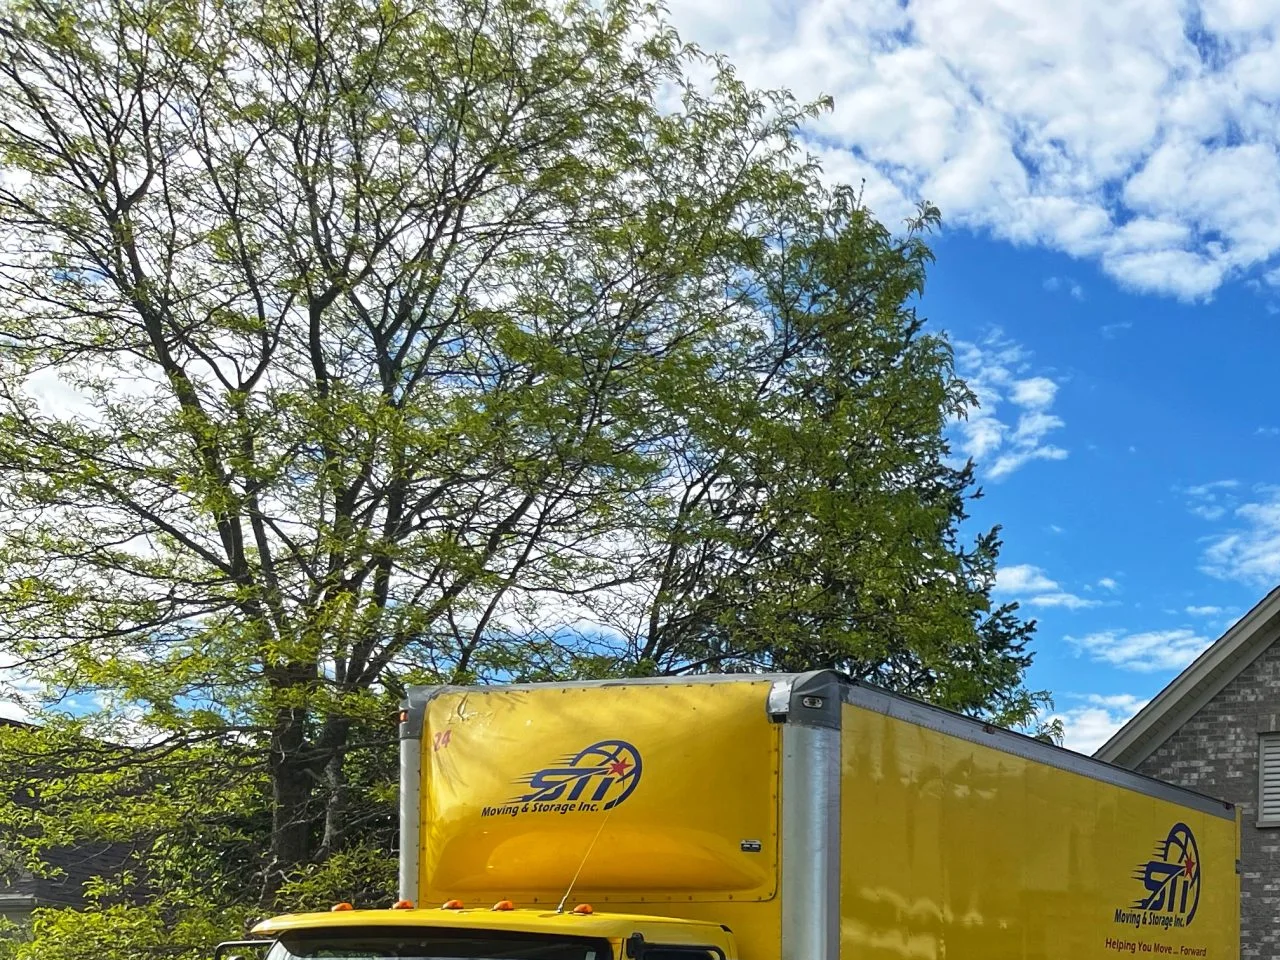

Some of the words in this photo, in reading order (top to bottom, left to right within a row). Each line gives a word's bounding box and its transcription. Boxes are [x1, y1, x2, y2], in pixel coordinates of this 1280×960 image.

[481, 803, 519, 817] Moving
[521, 803, 530, 813] &
[531, 802, 577, 814] Storage
[578, 801, 599, 812] Inc.
[1114, 908, 1141, 928] Moving
[1141, 912, 1147, 925] &
[1148, 912, 1174, 930] Storage
[1174, 914, 1185, 927] Inc.
[1105, 938, 1136, 953] Helping
[1137, 941, 1152, 952] You
[1180, 945, 1207, 957] Forward
